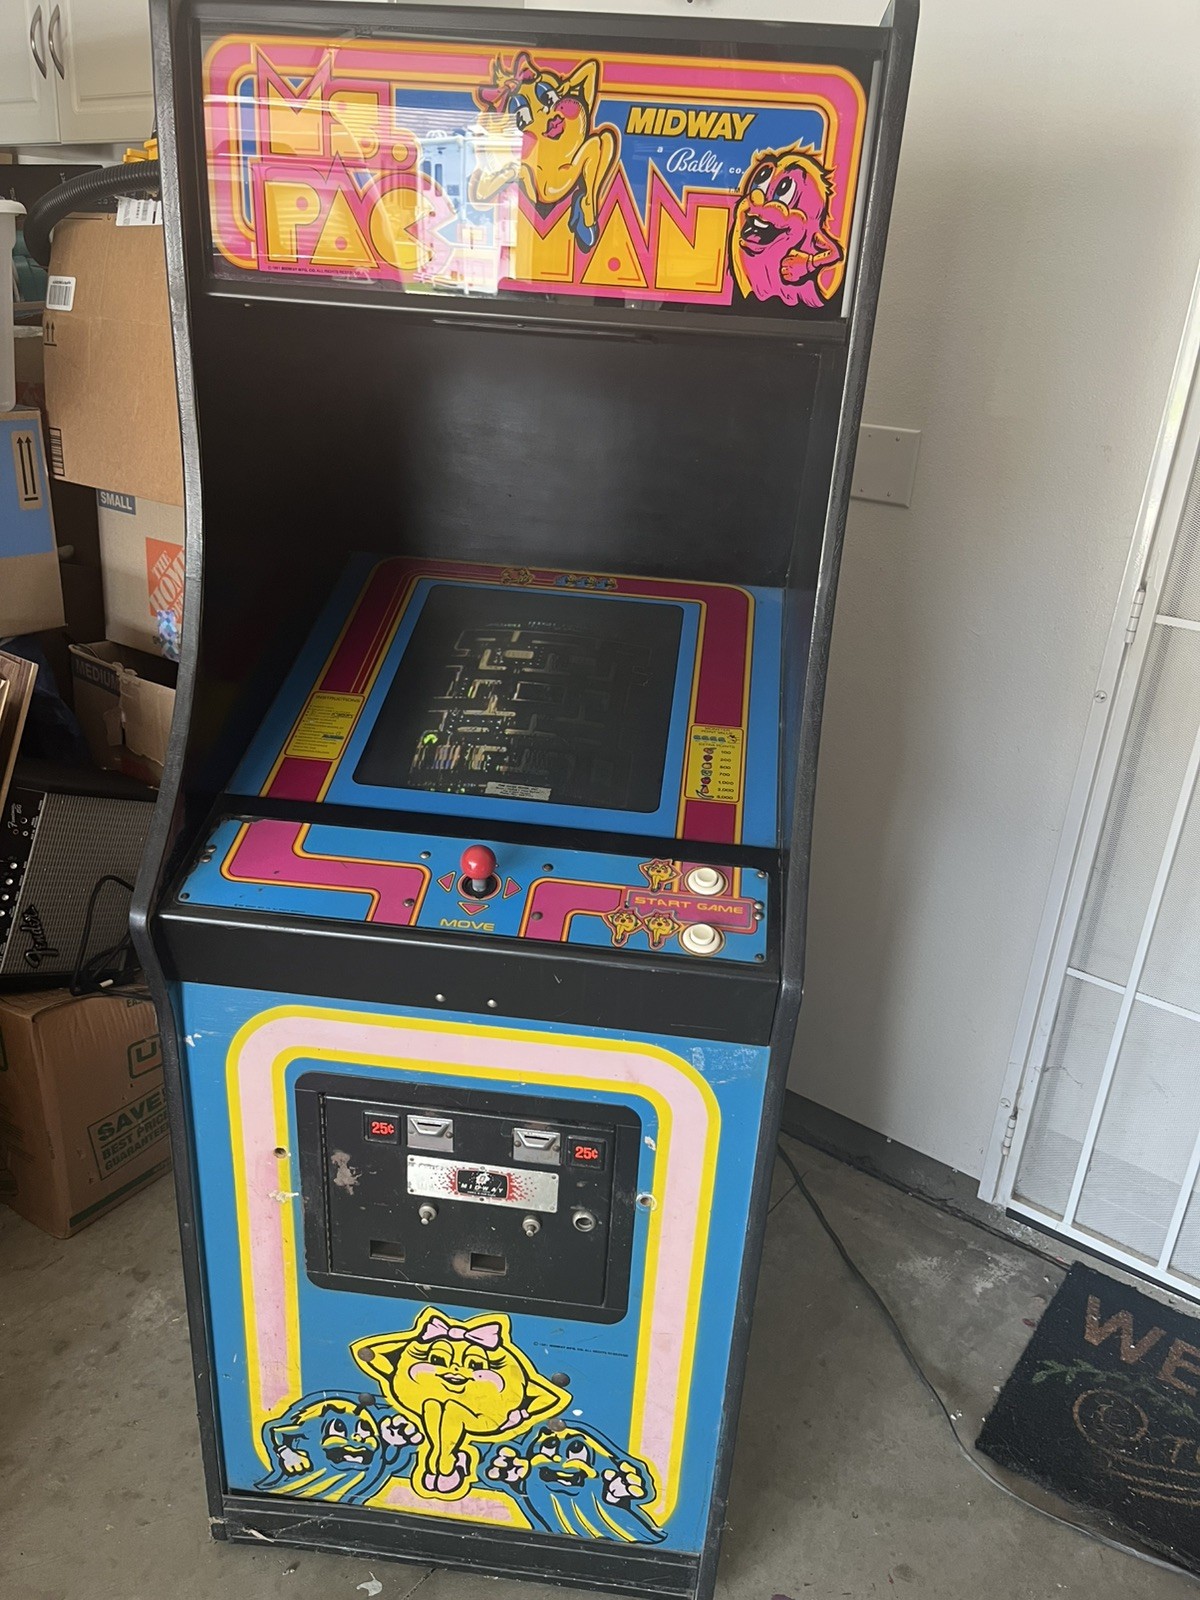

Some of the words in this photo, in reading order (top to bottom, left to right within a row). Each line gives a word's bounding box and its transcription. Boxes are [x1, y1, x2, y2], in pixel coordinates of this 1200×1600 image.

[625, 106, 756, 141] MIDWAY
[666, 147, 724, 181] Bally
[100, 491, 133, 511] SMALL
[152, 550, 172, 578] THE
[150, 549, 185, 612] HOM
[634, 896, 692, 909] START
[696, 902, 743, 914] GAME
[20, 904, 60, 968] Fender
[440, 918, 496, 932] MOVE
[371, 1120, 395, 1135] 25¢
[102, 1133, 133, 1161] BEST
[574, 1145, 599, 1160] 25¢
